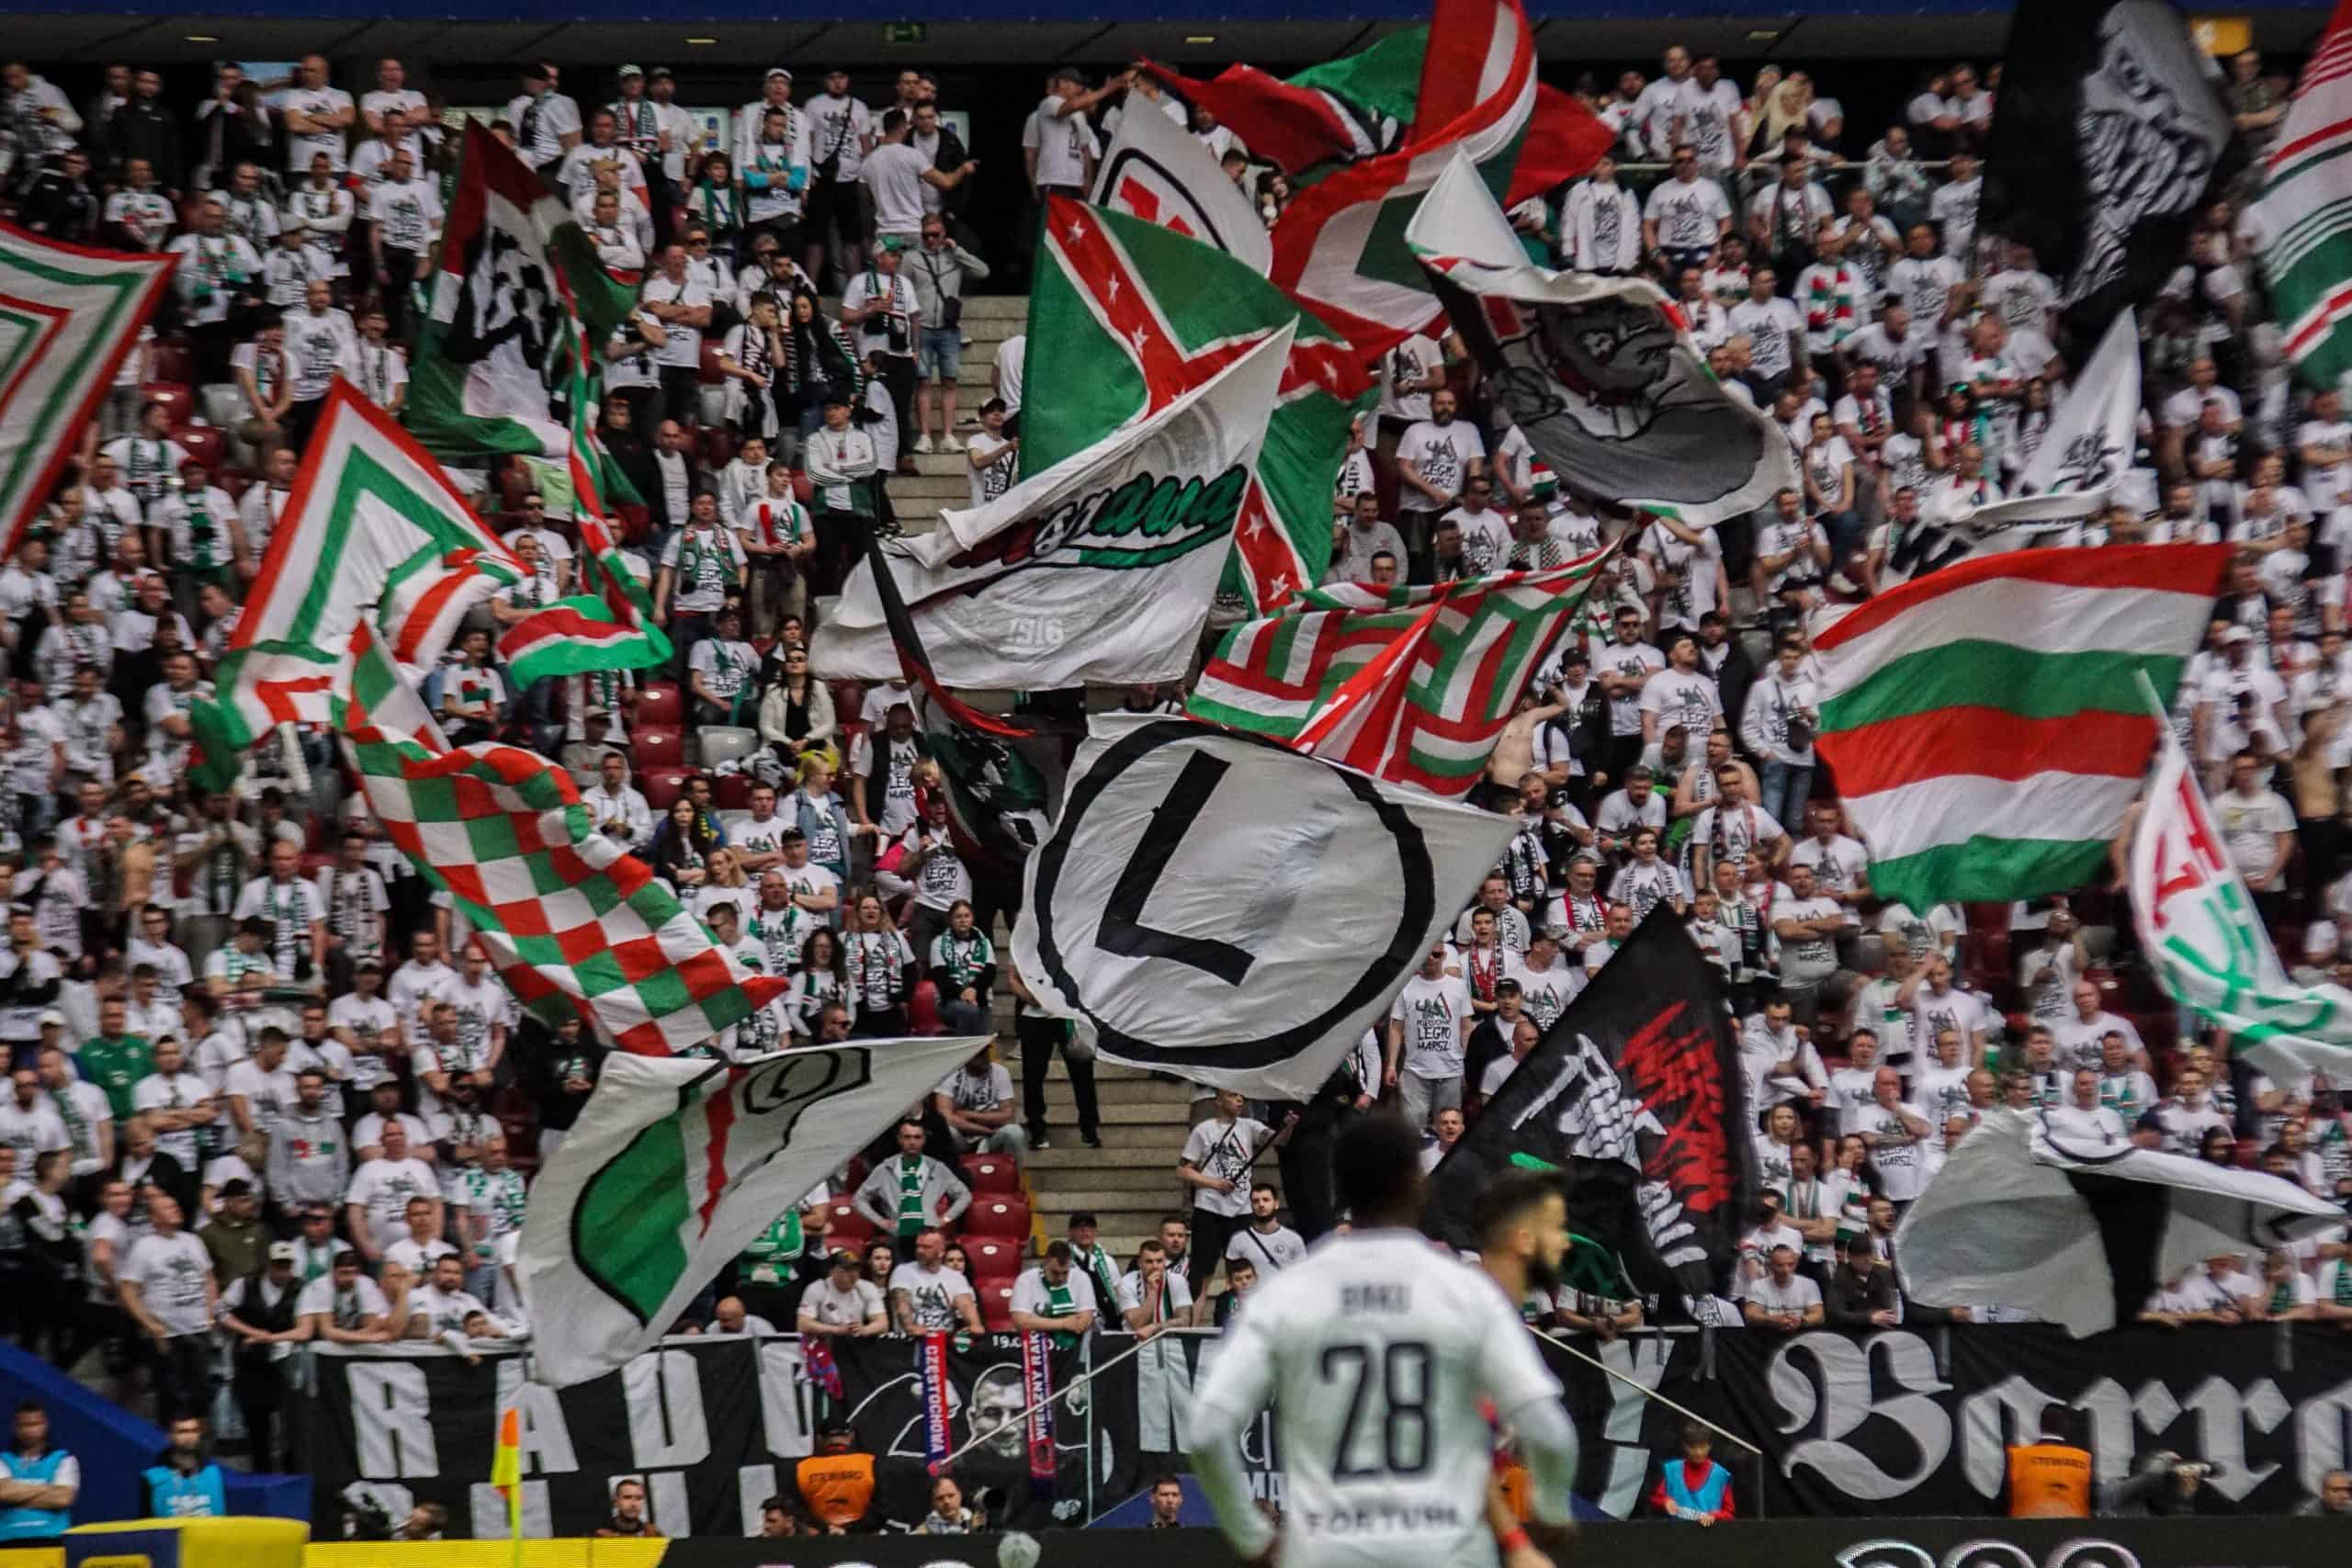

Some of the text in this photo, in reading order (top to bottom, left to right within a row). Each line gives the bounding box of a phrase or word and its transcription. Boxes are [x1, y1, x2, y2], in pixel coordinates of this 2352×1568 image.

[1095, 749, 1255, 987] L
[1418, 1026, 1452, 1041] LEGIO
[1319, 1340, 1433, 1485] 28
